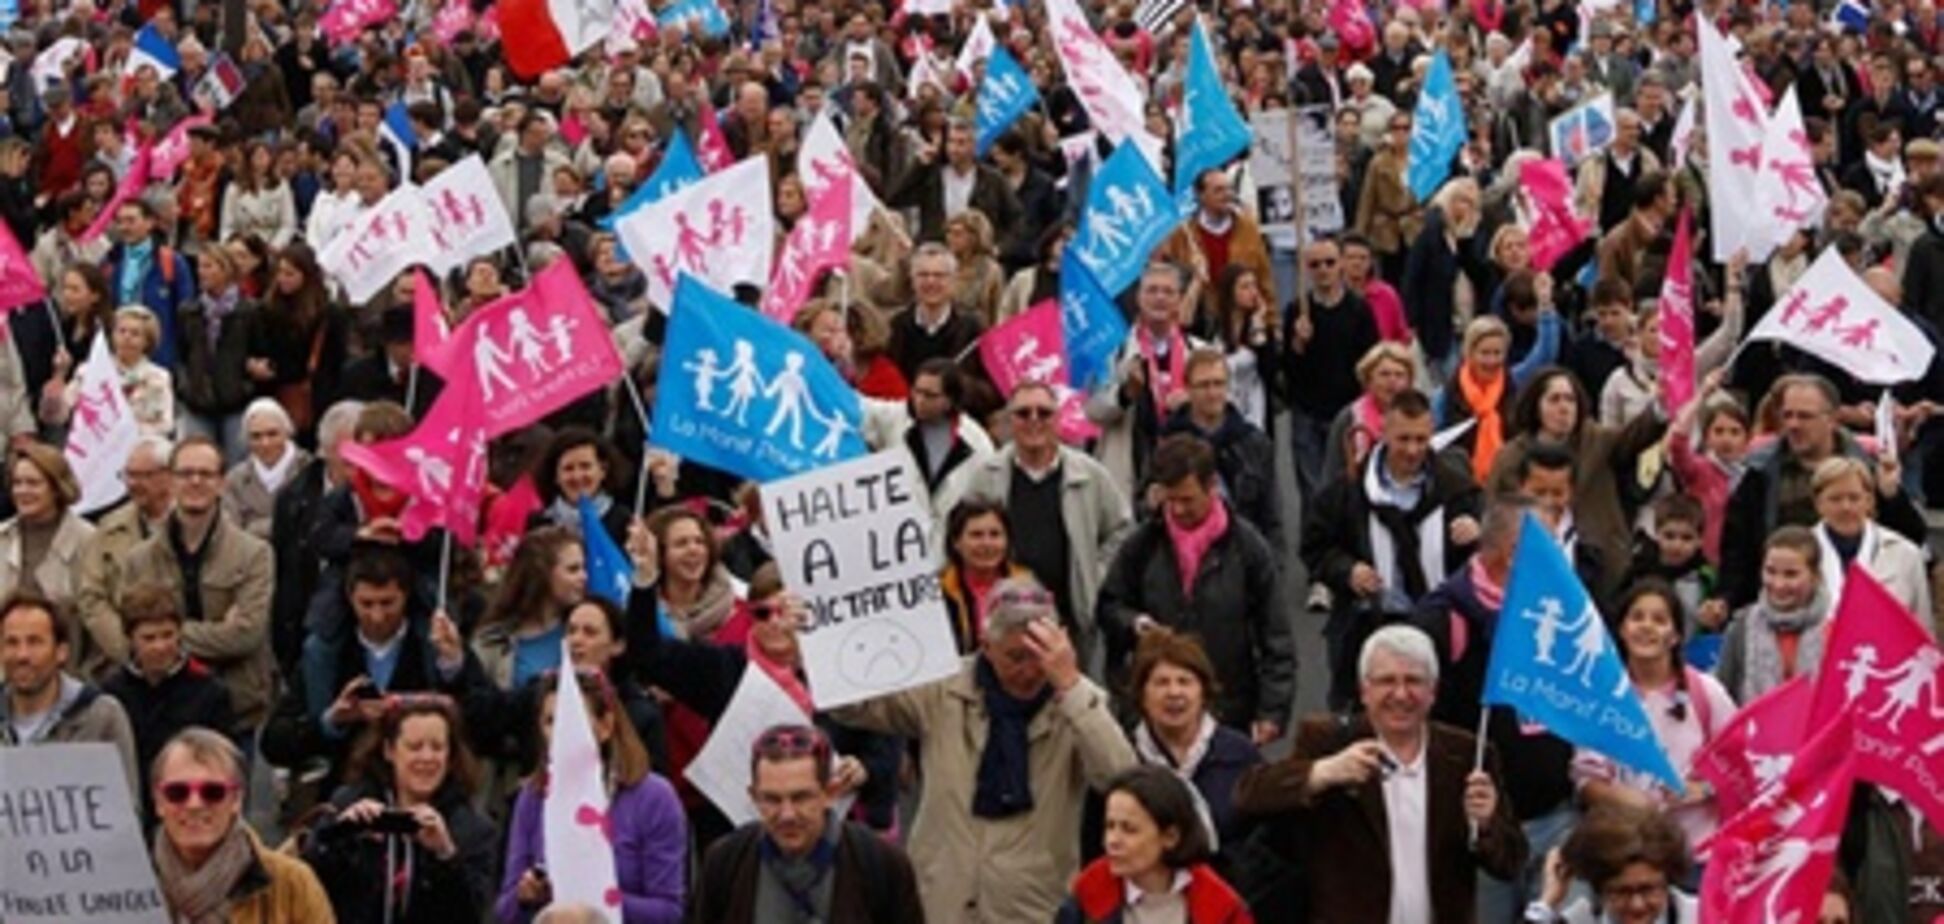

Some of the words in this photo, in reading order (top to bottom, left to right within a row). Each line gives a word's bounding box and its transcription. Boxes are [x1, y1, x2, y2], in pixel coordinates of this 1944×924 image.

[776, 465, 910, 531] HALTE
[802, 538, 839, 585] A
[868, 518, 927, 570] LA
[1499, 668, 1529, 694] La
[1532, 676, 1600, 718] Manif
[60, 848, 94, 873] LA
